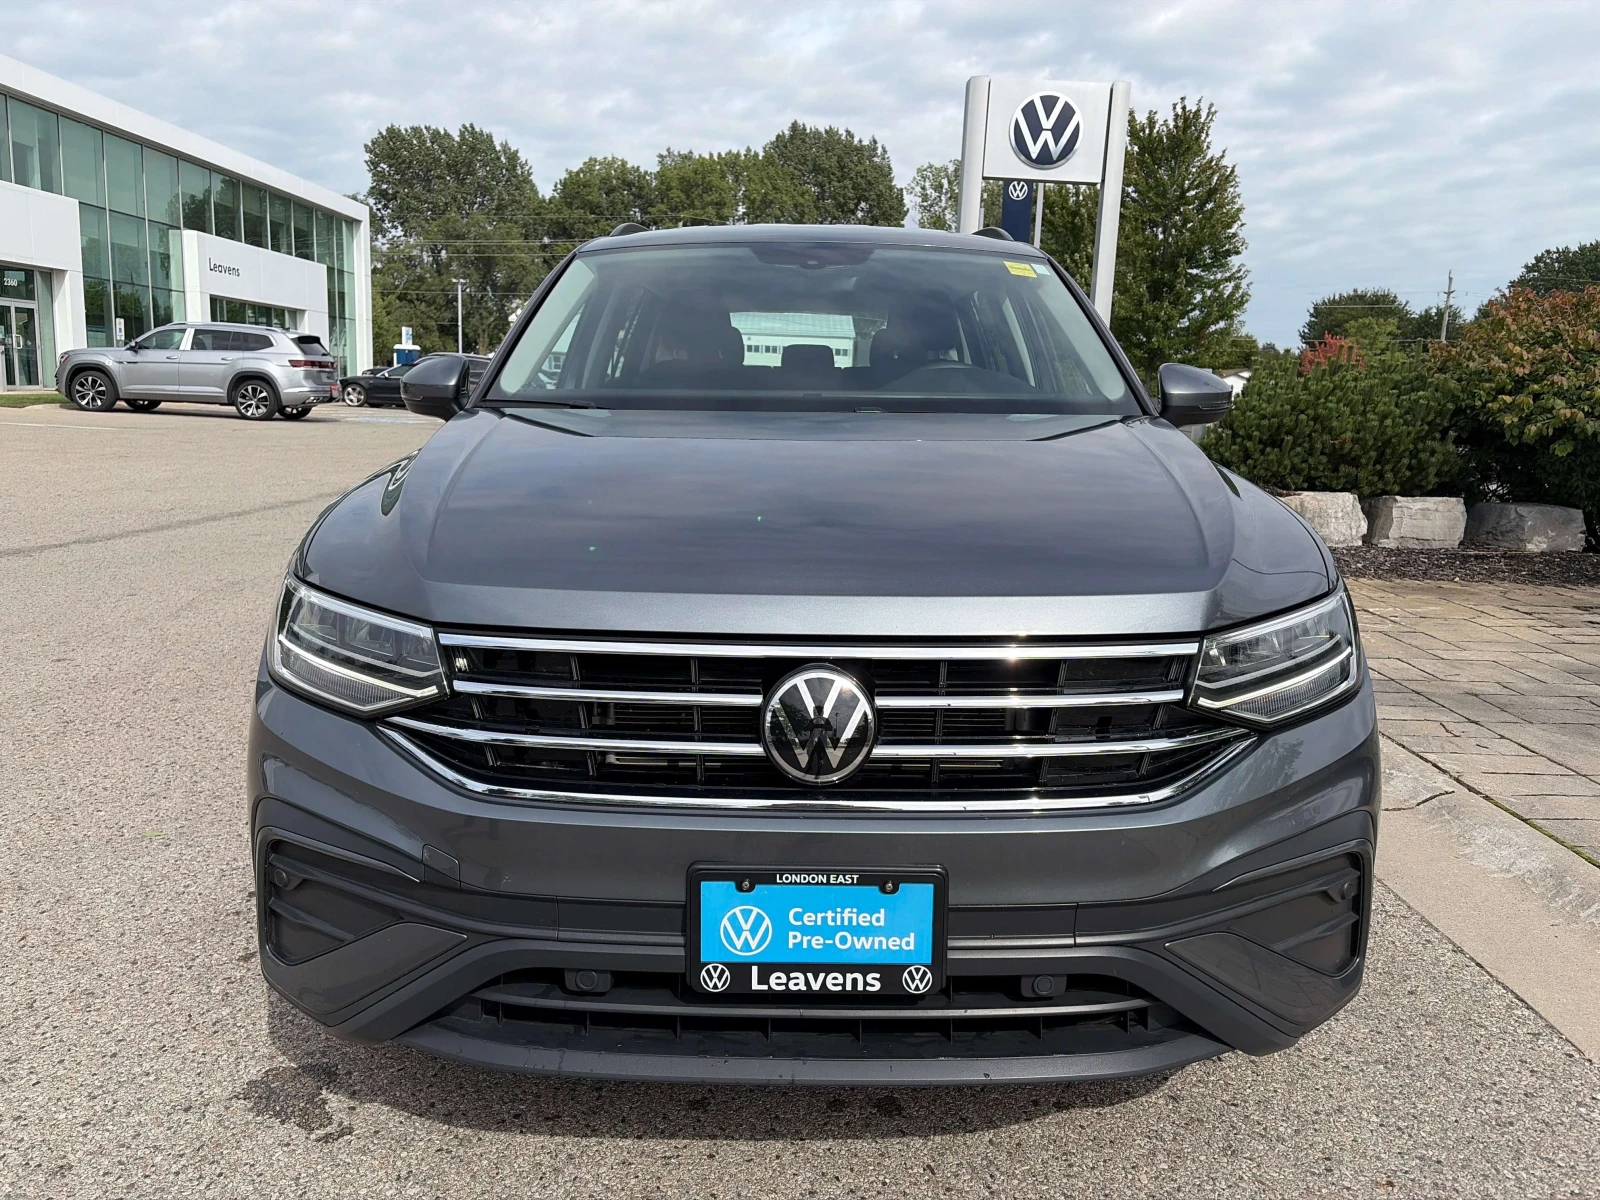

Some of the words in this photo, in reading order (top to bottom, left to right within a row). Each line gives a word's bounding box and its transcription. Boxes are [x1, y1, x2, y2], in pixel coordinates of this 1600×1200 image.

[209, 257, 241, 277] Leavens
[4, 277, 18, 287] 2360
[776, 874, 827, 884] LONDON
[829, 874, 859, 885] EAST
[788, 908, 885, 926] Certified
[788, 931, 915, 950] Pre-Owned
[751, 965, 882, 992] Leavens
